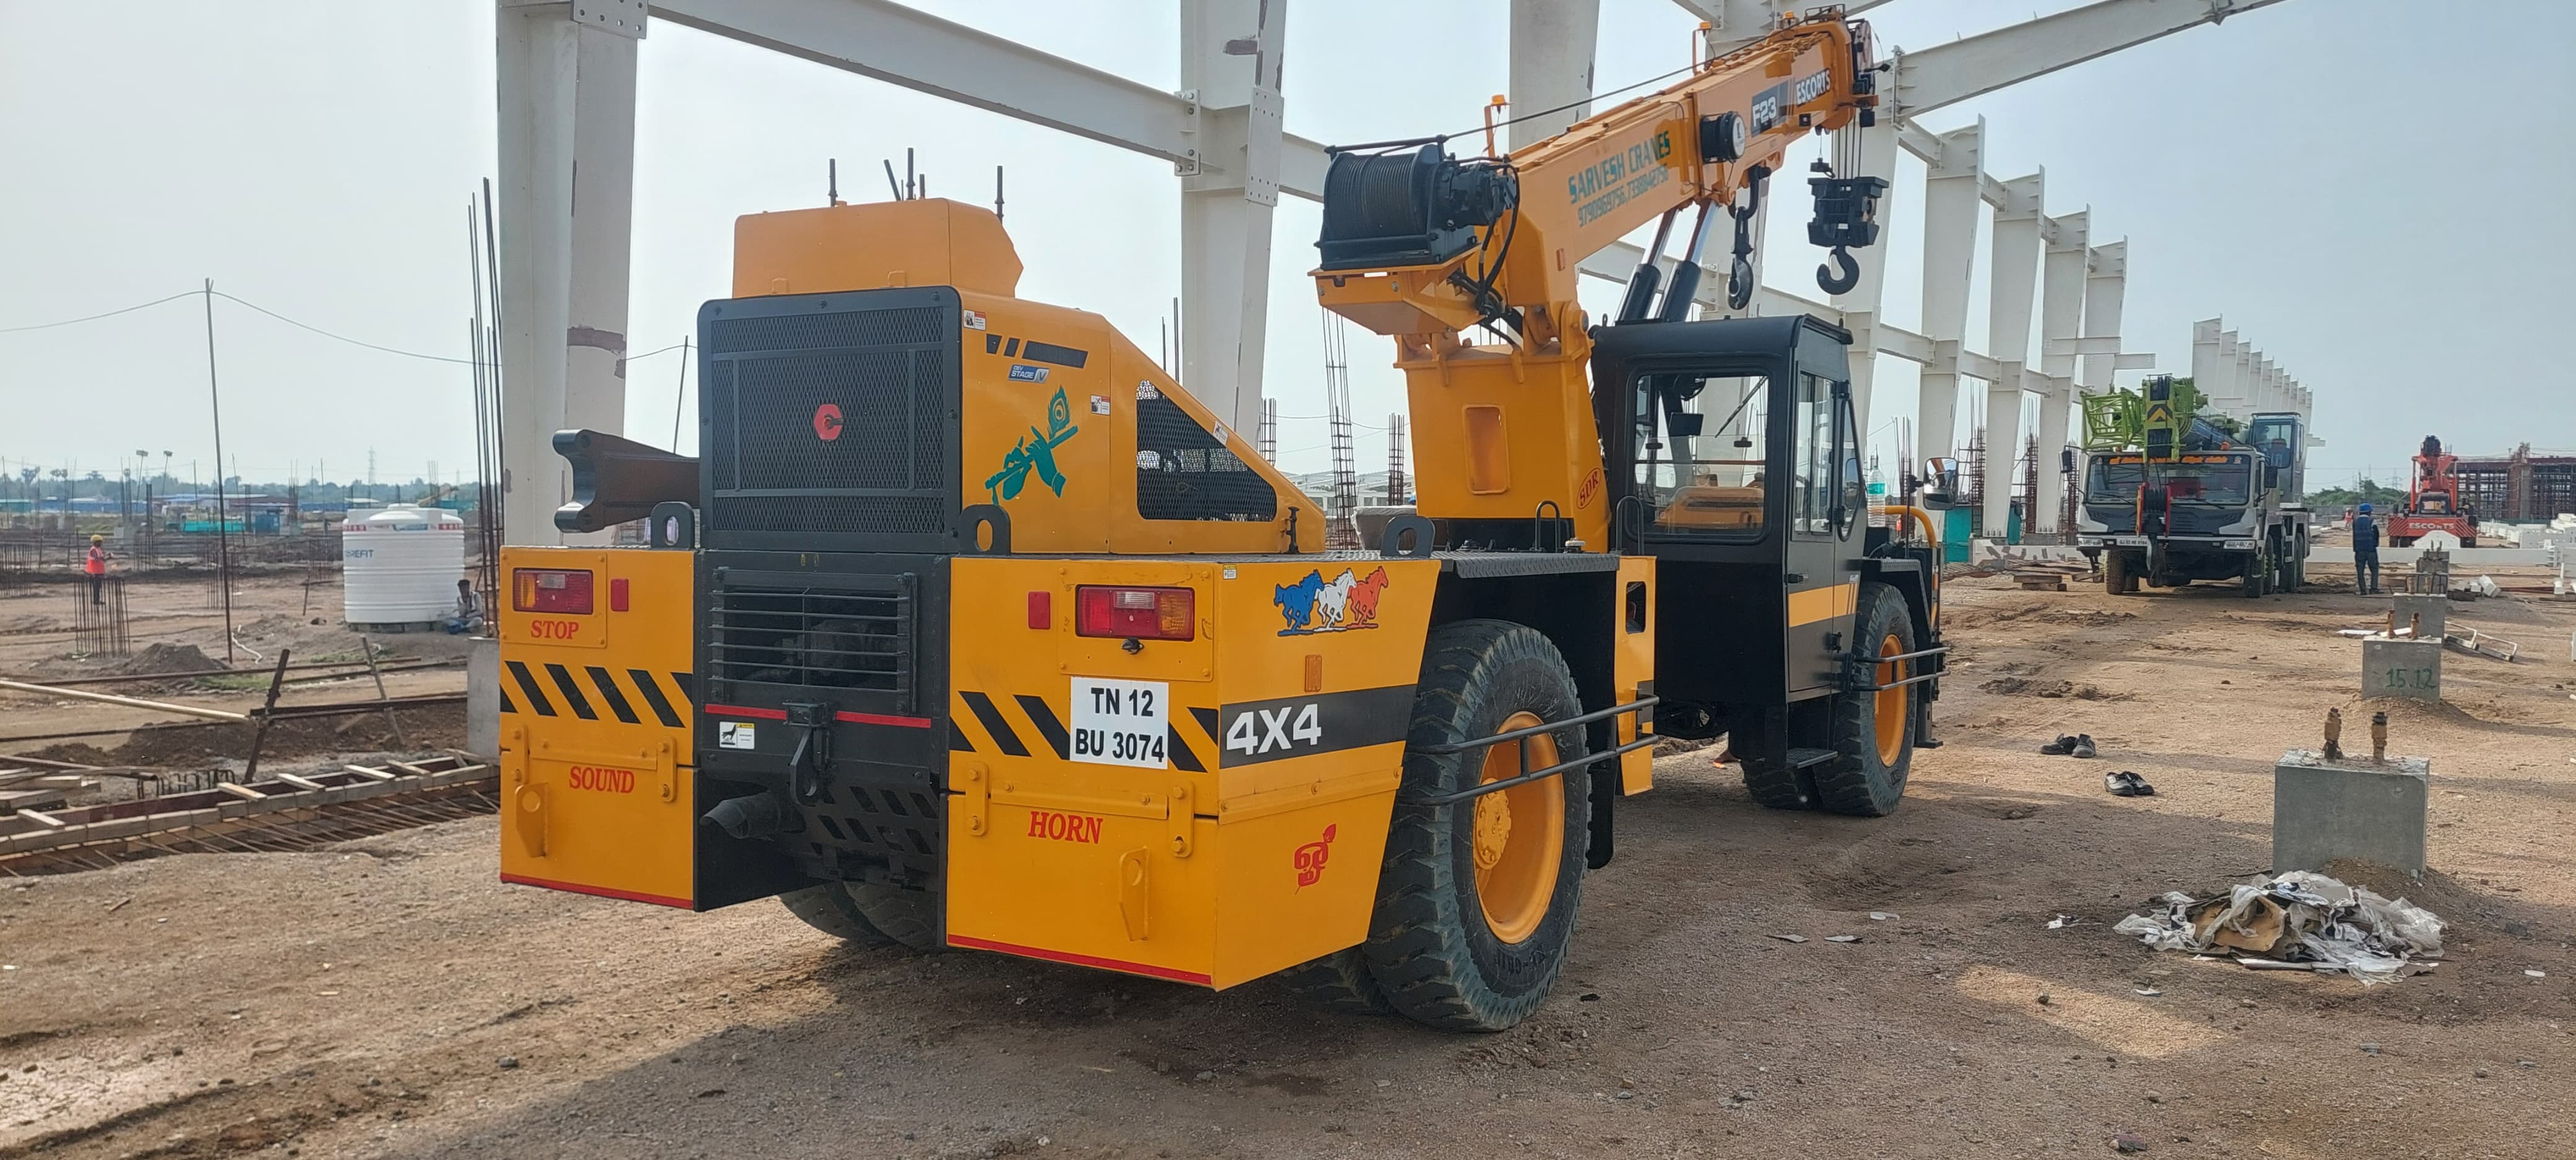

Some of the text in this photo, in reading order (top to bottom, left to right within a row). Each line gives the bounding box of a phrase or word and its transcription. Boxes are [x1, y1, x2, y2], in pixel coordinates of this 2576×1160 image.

[1796, 69, 1831, 105] ESCORTS
[1752, 96, 1777, 128] F23
[1569, 131, 1671, 204] SARVESH CRANES
[1011, 371, 1035, 379] STAGE
[1580, 470, 1598, 507] SDR
[531, 620, 579, 639] STOP
[2385, 667, 2436, 690] 15.12
[1090, 687, 1154, 717] TN 12
[1075, 728, 1165, 763] BU 3074
[1225, 703, 1322, 756] 4X4
[569, 766, 635, 794] SOUND
[1028, 811, 1103, 844] HORN
